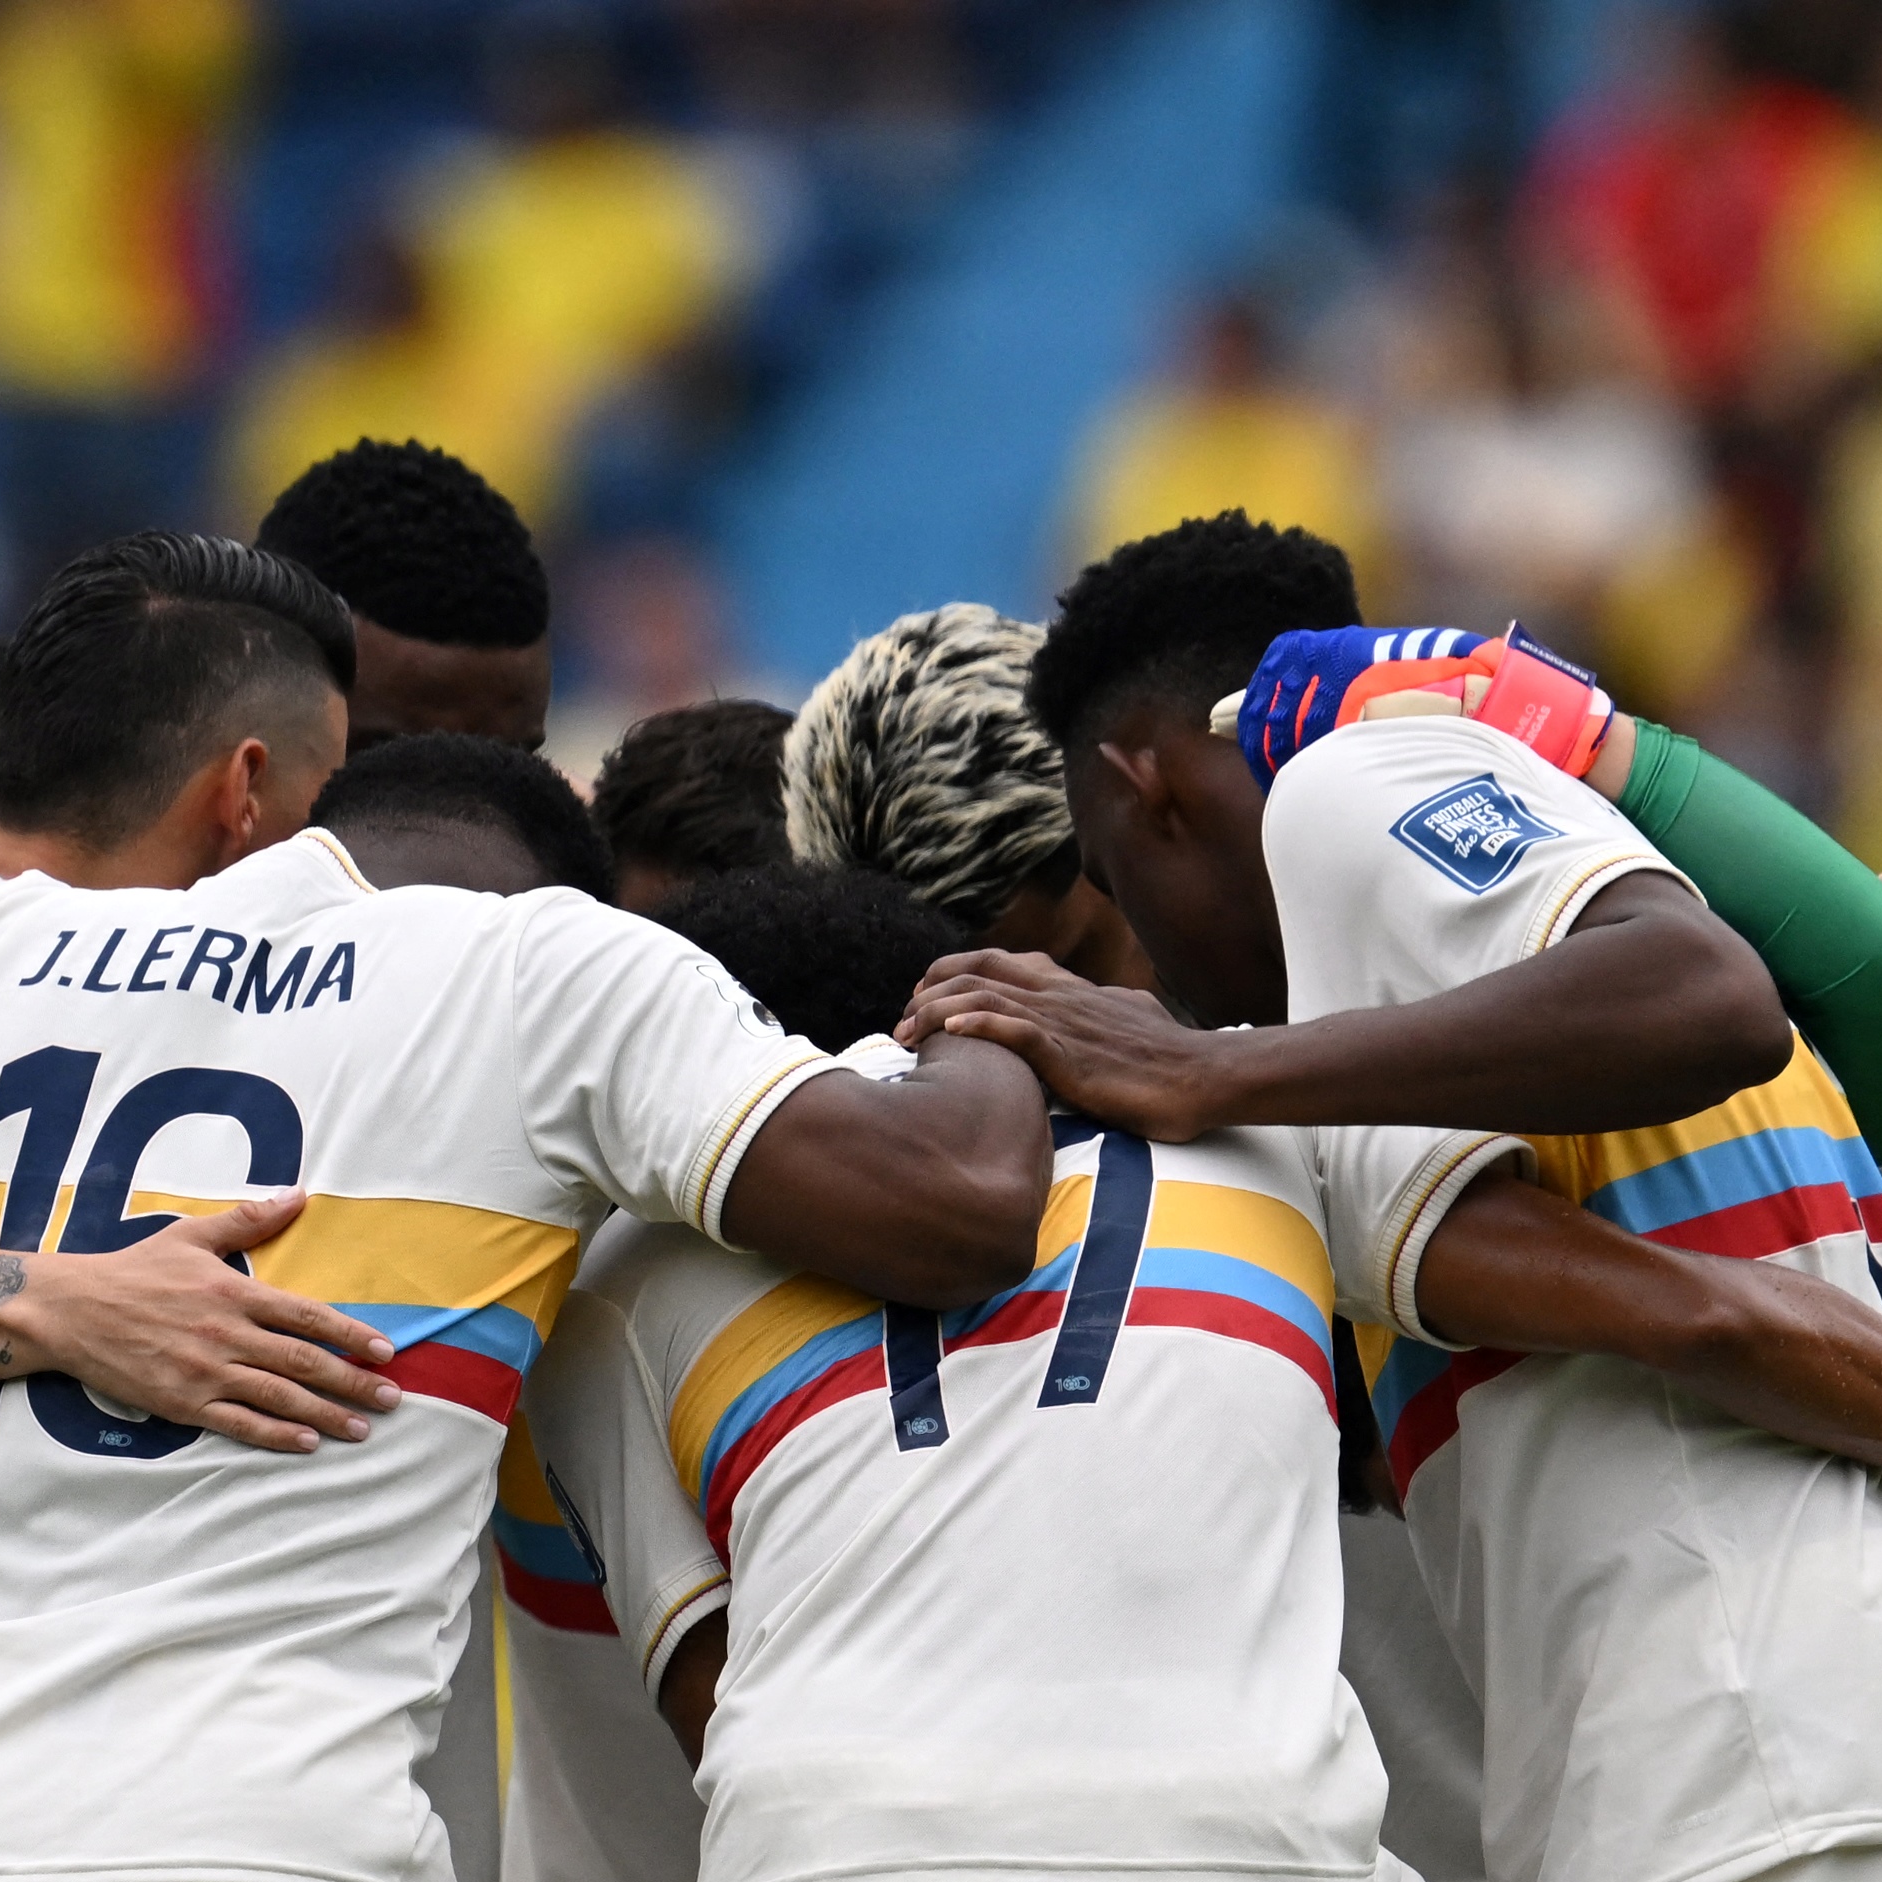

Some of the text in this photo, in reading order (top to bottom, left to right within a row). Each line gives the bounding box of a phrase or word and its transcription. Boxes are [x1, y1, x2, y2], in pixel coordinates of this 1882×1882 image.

[1511, 703, 1537, 738] AMILO
[1524, 705, 1552, 747] ARGAS
[1423, 792, 1490, 830] FOOTBALL
[1453, 833, 1478, 859] the
[18, 924, 356, 1014] J.LERMA
